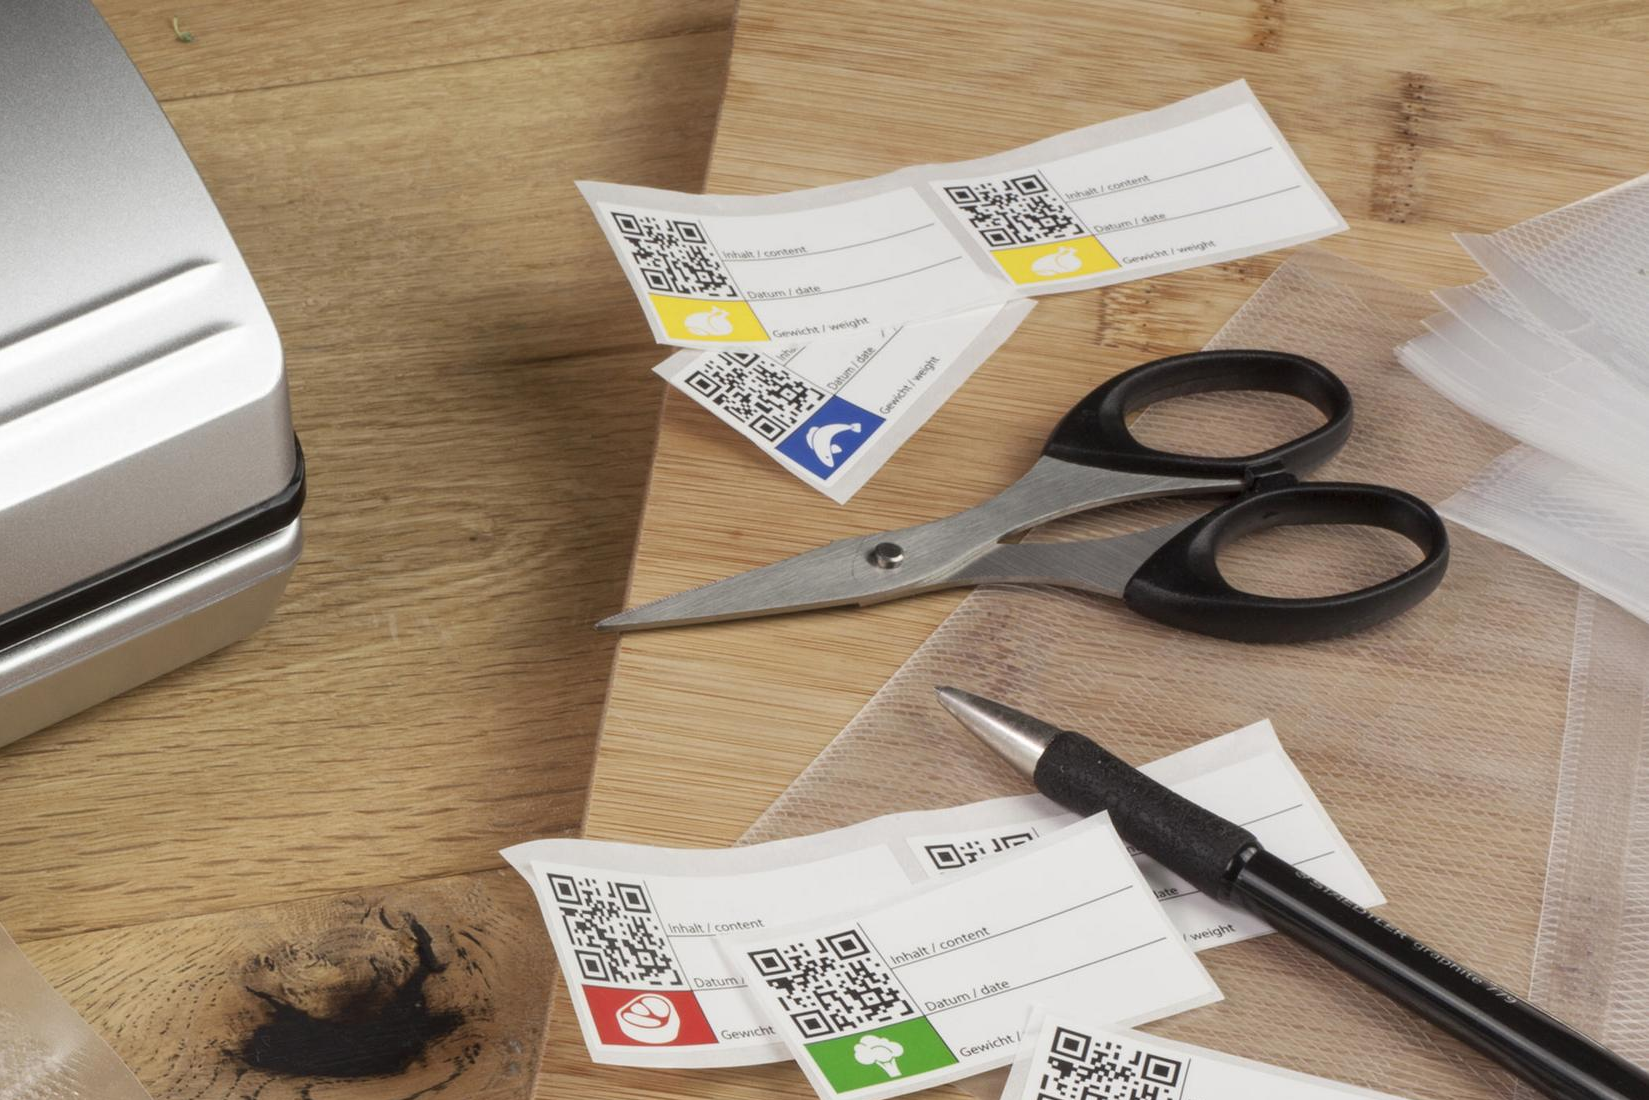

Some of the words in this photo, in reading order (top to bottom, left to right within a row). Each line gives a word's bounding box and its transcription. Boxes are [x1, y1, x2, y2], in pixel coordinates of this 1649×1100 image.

[1065, 186, 1098, 200] Inhalt
[1107, 175, 1150, 192] content
[1094, 220, 1132, 233] Datum
[1141, 212, 1166, 224] date
[722, 249, 755, 260] Inhalt
[763, 245, 807, 258] content
[1122, 249, 1168, 264] Gewicht
[1177, 239, 1216, 253] weight
[747, 288, 785, 300] Datum
[796, 284, 821, 296] date
[772, 323, 821, 339] Gewicht
[829, 316, 869, 330] weight
[826, 365, 854, 392] Datum
[857, 346, 876, 364] date
[879, 388, 911, 415] Gewicht
[913, 355, 940, 383] weight
[668, 923, 704, 934] Inhalt
[714, 919, 765, 933] content
[1190, 924, 1236, 943] weight
[890, 946, 930, 965] Inhalt
[940, 927, 990, 950] content
[1413, 941, 1483, 985] graphite
[693, 977, 738, 988] Datum
[924, 992, 971, 1012] Datum
[981, 980, 1010, 996] date
[721, 1025, 776, 1040] Gewicht
[960, 1034, 1015, 1058] Gewicht
